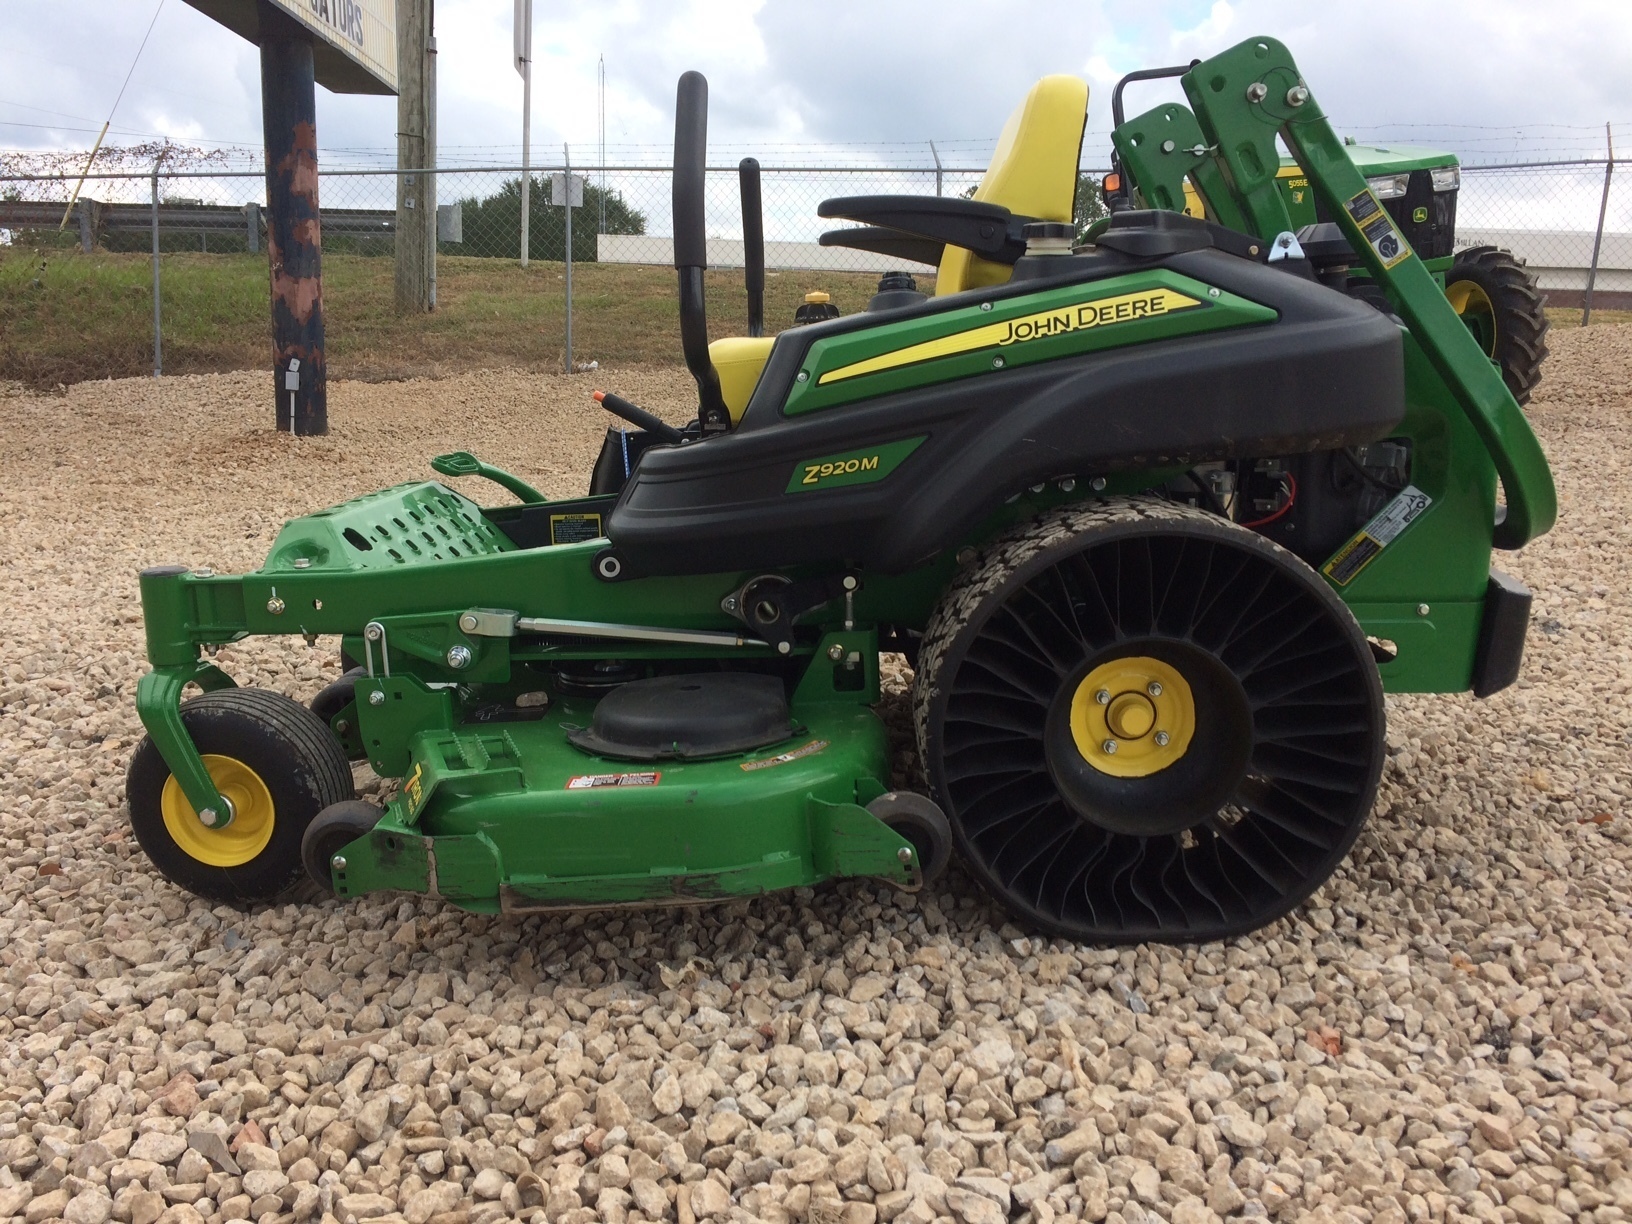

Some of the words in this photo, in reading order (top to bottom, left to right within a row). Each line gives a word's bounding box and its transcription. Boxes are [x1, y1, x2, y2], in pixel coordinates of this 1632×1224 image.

[999, 313, 1071, 343] JOHN
[1077, 295, 1166, 327] DEERE
[802, 455, 879, 485] Z920M
